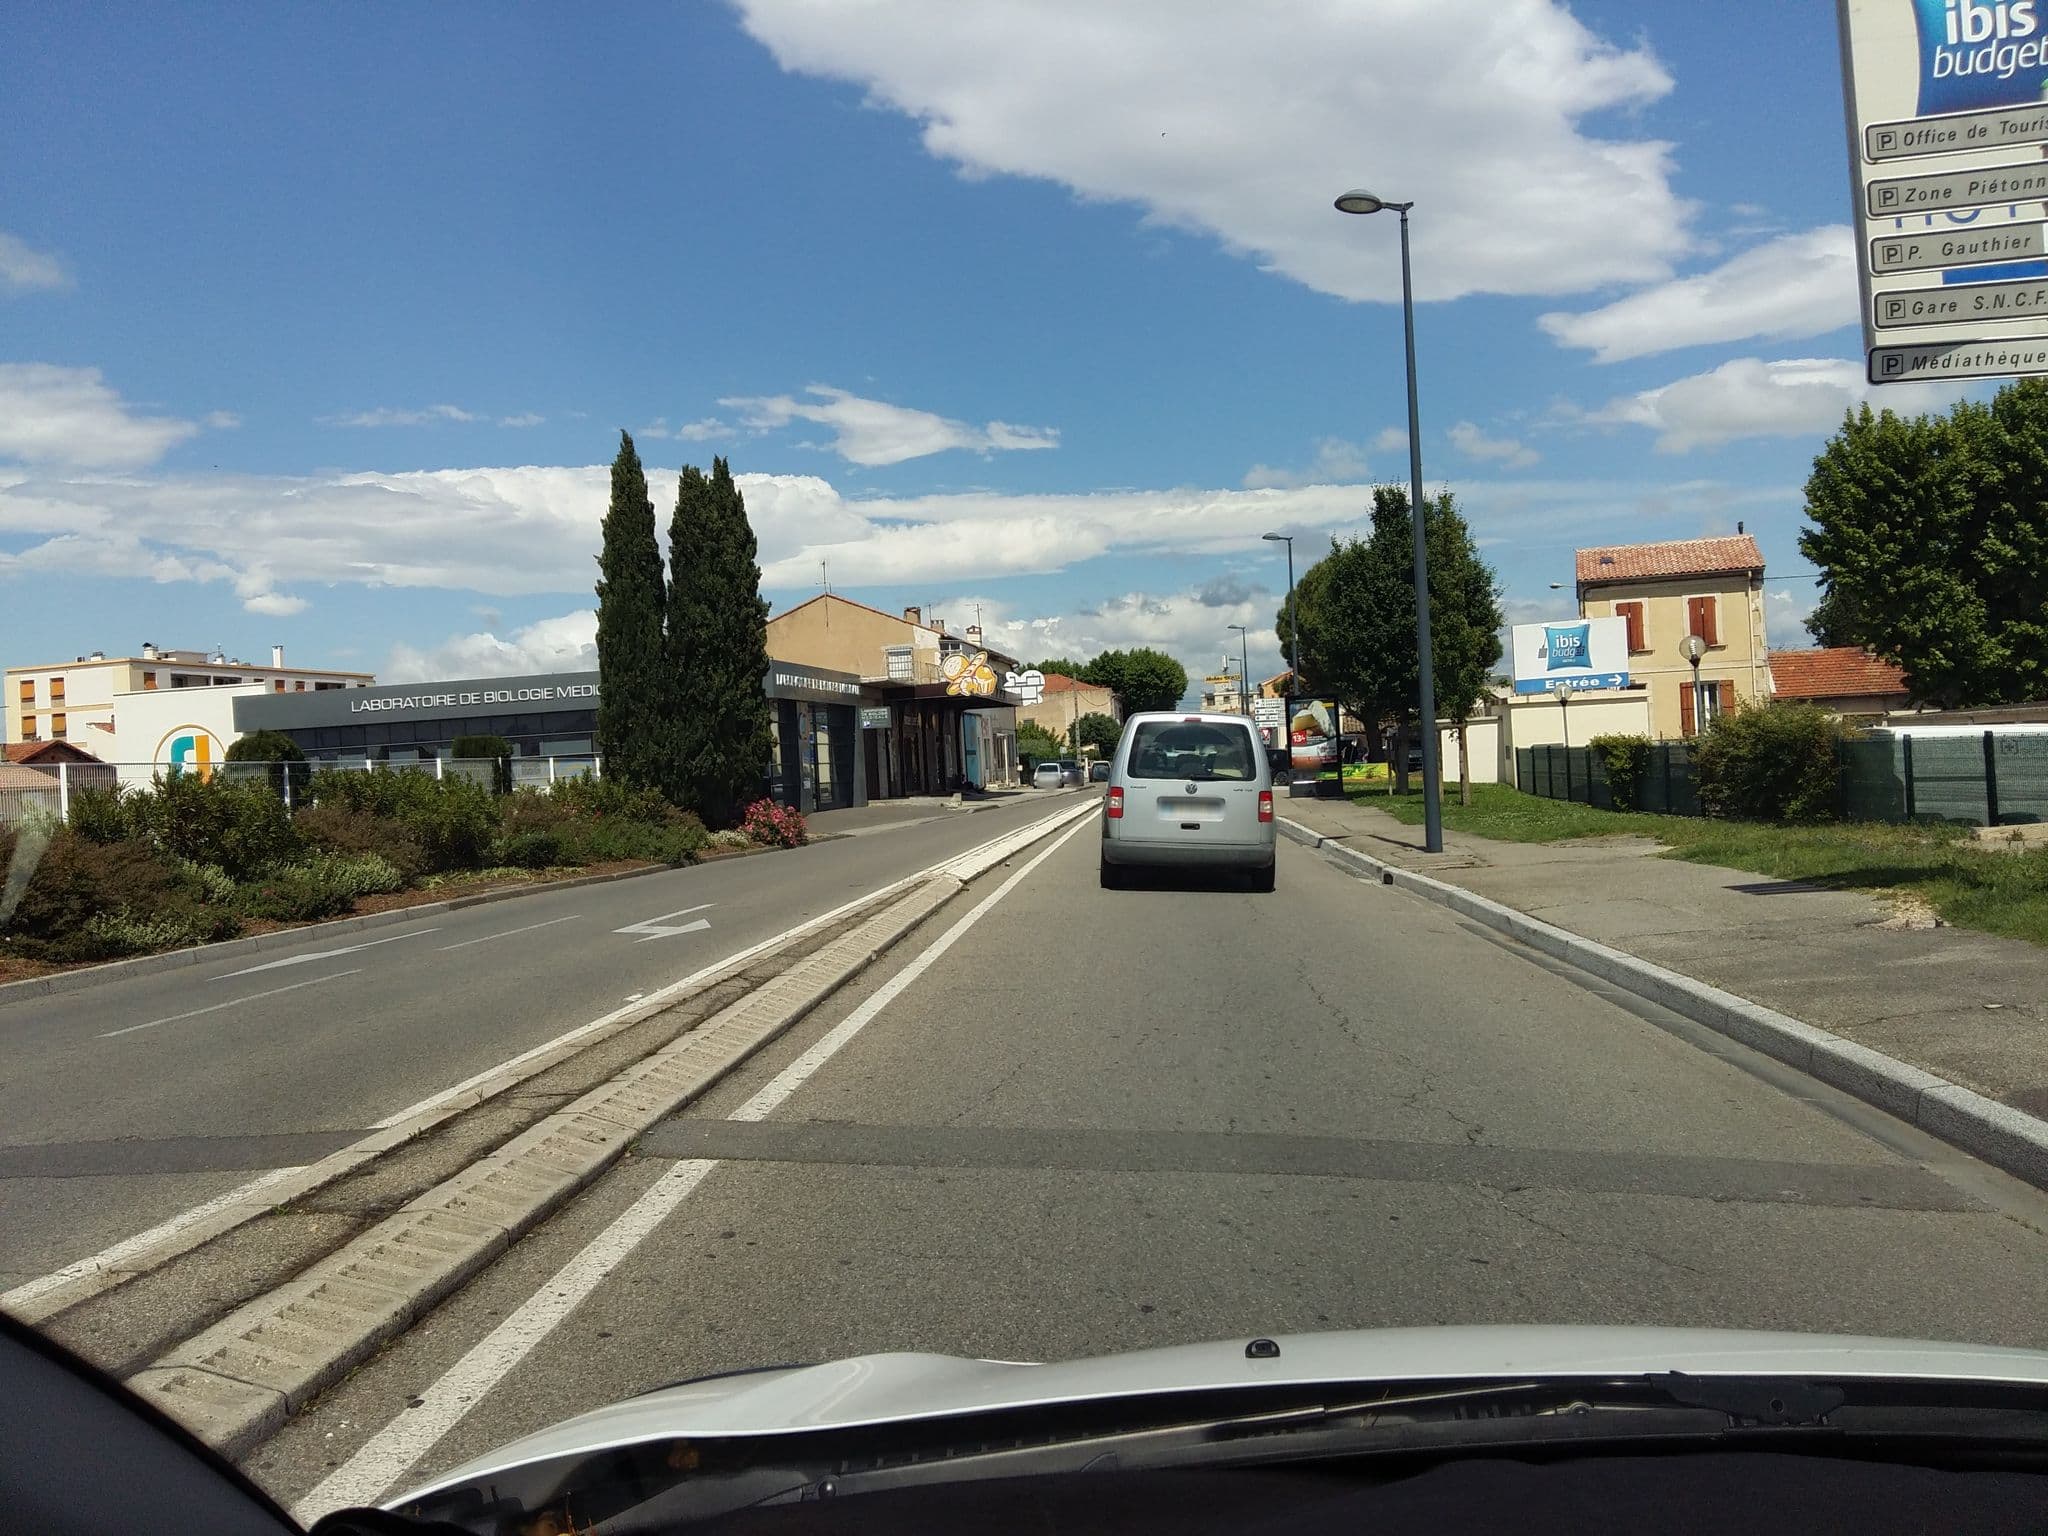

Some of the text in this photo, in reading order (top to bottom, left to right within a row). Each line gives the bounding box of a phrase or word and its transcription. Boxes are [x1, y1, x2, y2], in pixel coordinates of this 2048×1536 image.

[1945, 0, 2037, 44] ibis
[1933, 35, 2048, 79] budget
[1903, 130, 1957, 146] Office
[1967, 125, 1988, 139] de
[1905, 187, 1953, 203] Zone
[1968, 177, 2046, 196] Piétonn
[1908, 245, 1922, 260] P.
[1942, 236, 2031, 256] Gauthier
[1912, 300, 1958, 315] Gare
[1973, 290, 2048, 310] S.N.C.F.
[1911, 351, 2047, 371] Médiathèque
[1556, 634, 1580, 648] ibis
[351, 694, 457, 713] LABORATOIRE
[459, 692, 481, 705] DE
[483, 688, 553, 704] BIOLOGIE
